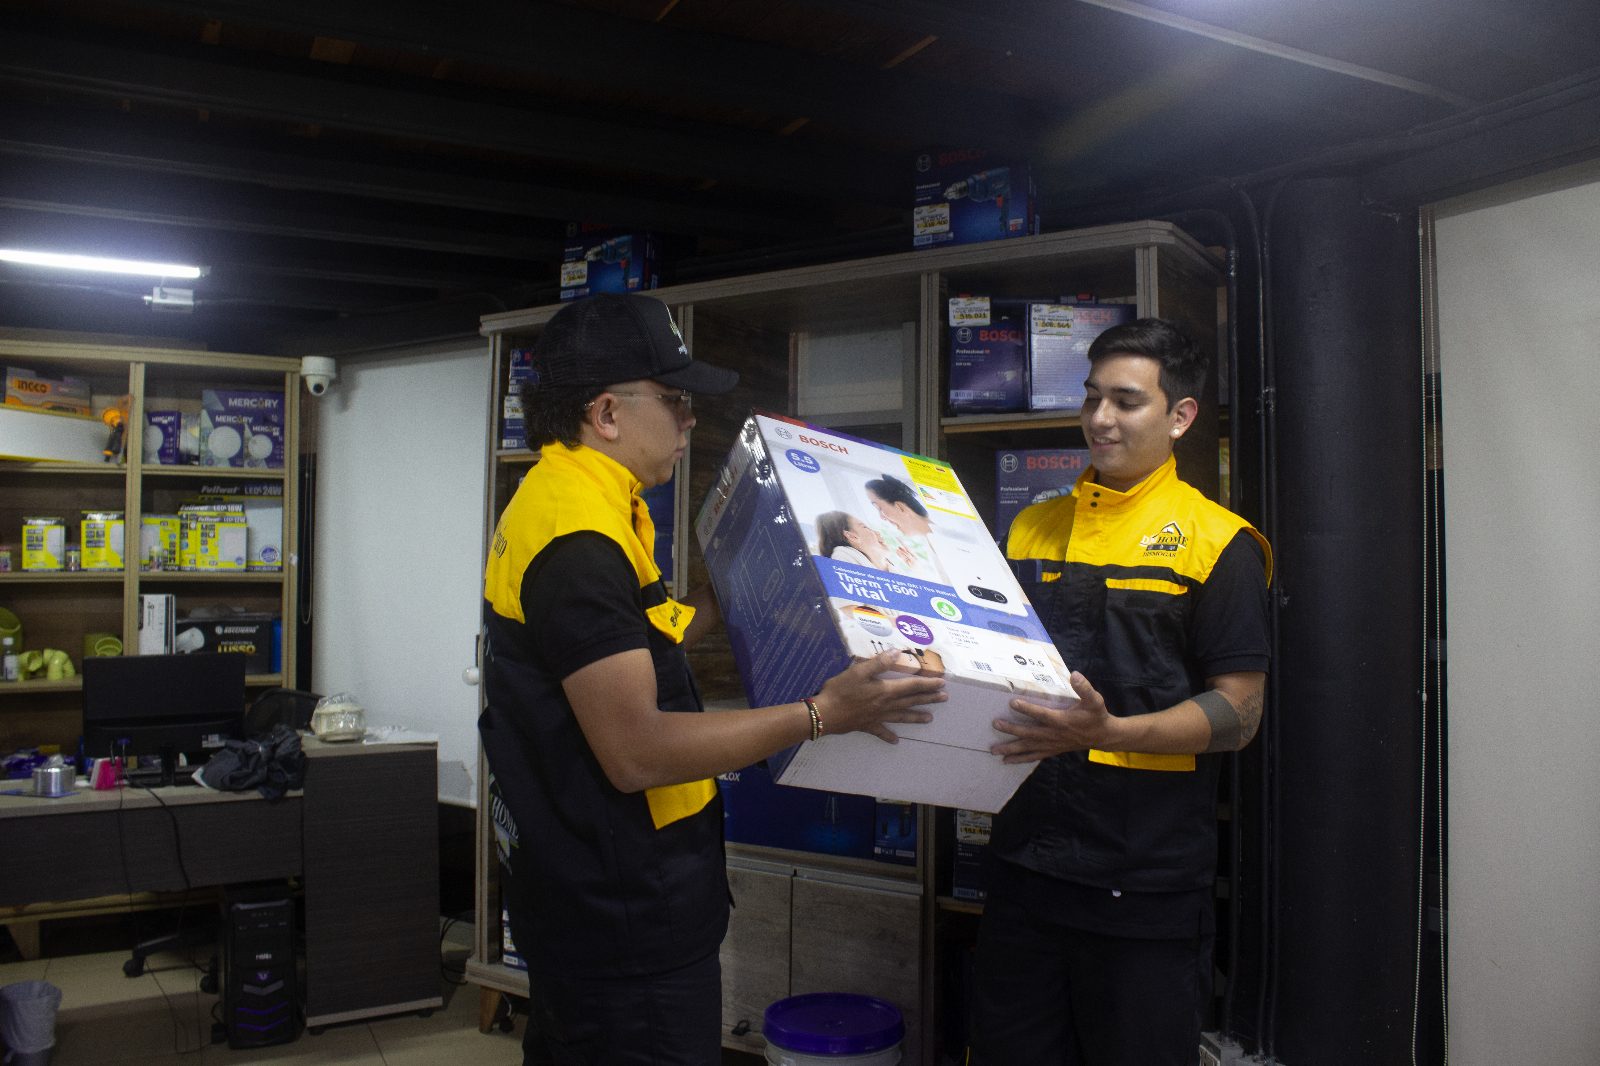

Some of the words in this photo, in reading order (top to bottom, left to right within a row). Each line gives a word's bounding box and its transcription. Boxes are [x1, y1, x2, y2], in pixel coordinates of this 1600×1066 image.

[798, 434, 849, 455] BOSCH
[790, 452, 814, 465] 5.5
[1027, 455, 1081, 470] BOSCH
[835, 571, 882, 590] Therm
[884, 582, 918, 598] 1500
[840, 582, 889, 603] Vital
